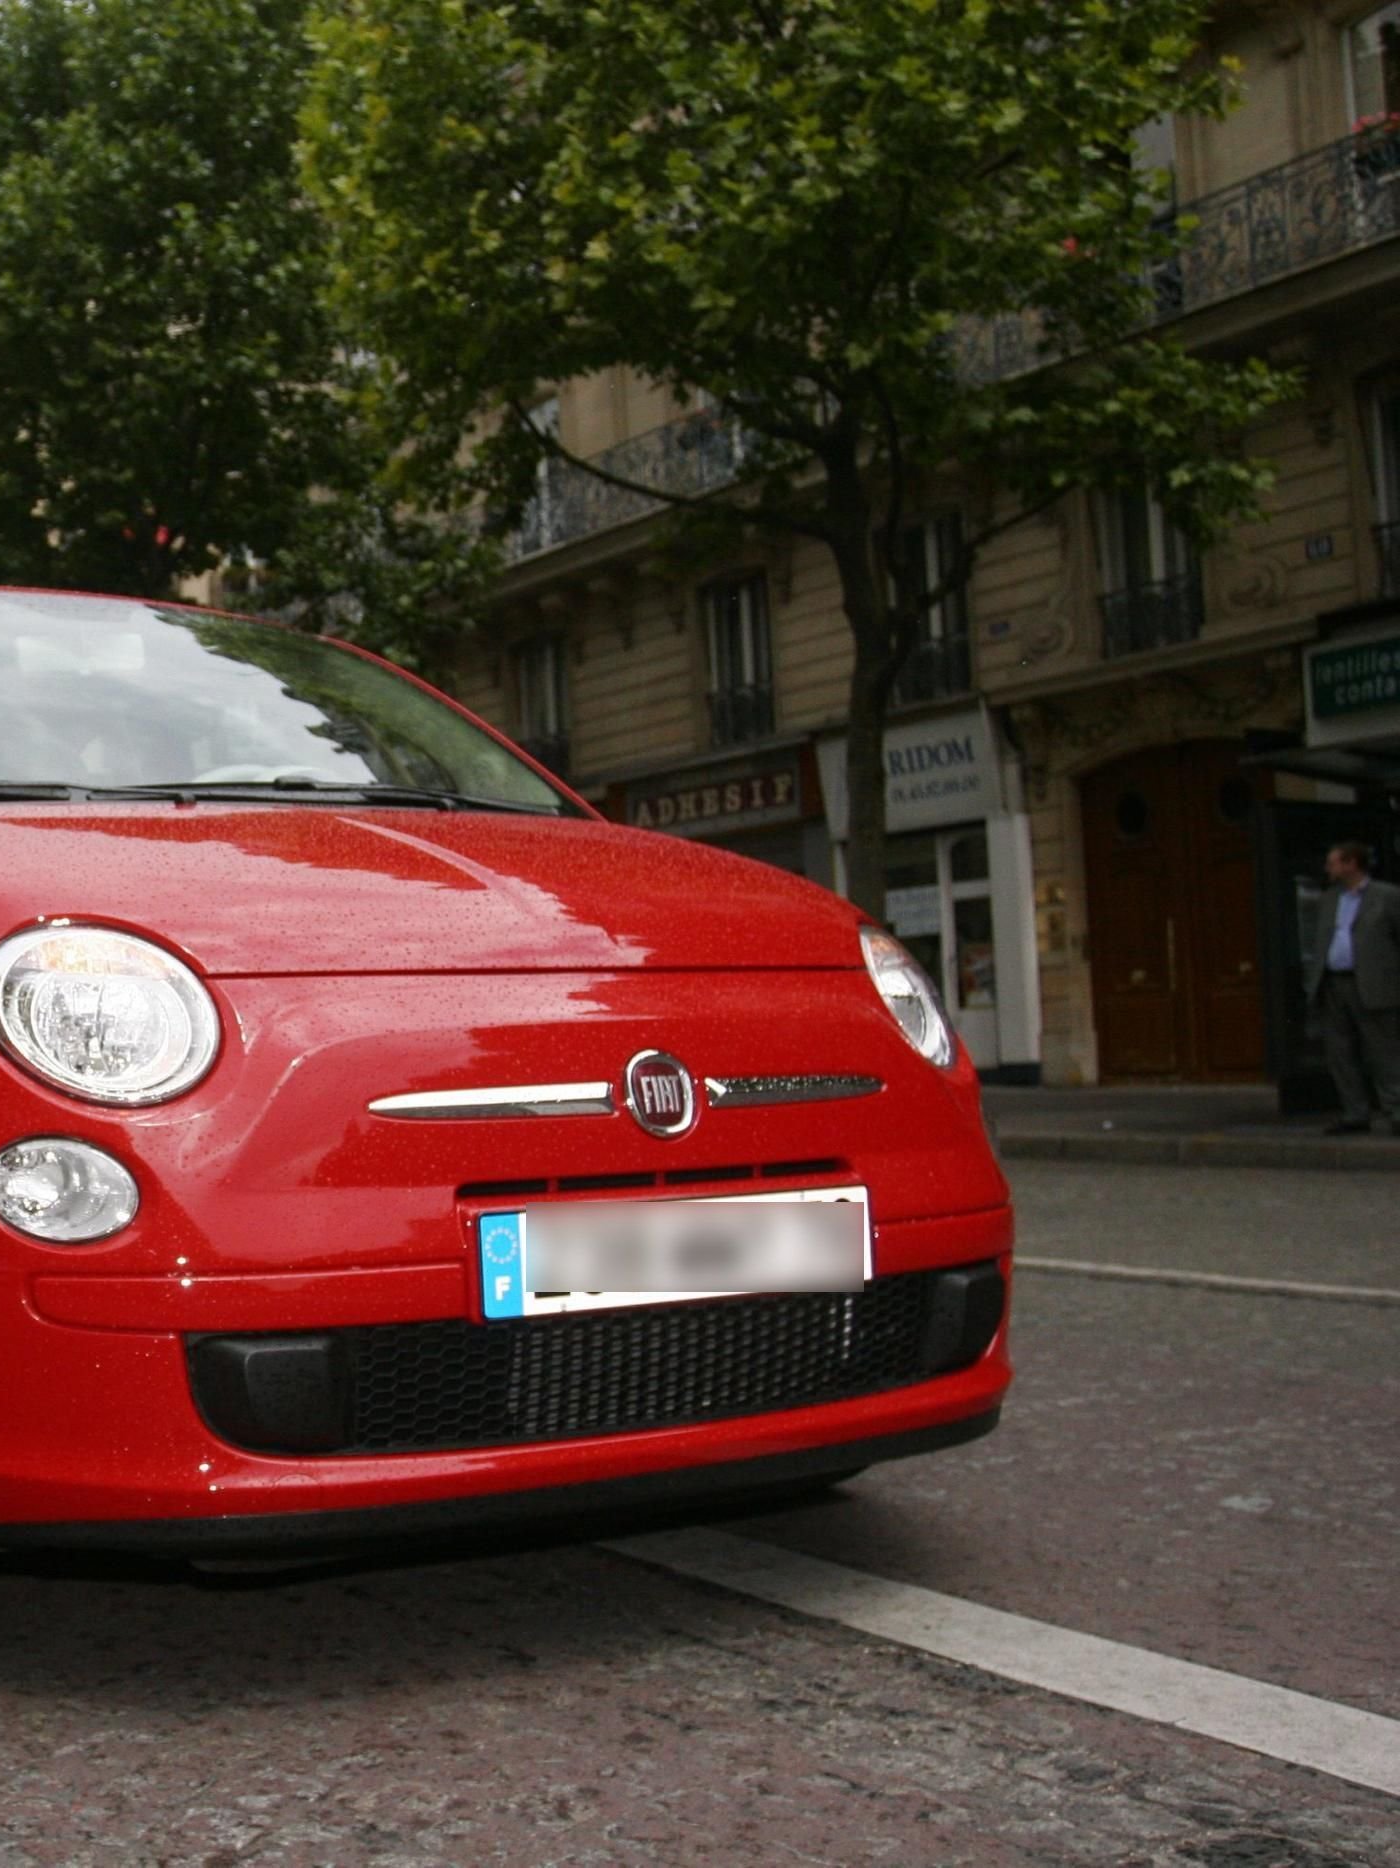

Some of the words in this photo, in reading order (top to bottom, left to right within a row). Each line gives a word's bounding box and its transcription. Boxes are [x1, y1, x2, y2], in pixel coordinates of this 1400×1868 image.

[636, 772, 792, 827] ADHESIF
[641, 1075, 680, 1114] FIAT
[495, 1275, 512, 1302] F
